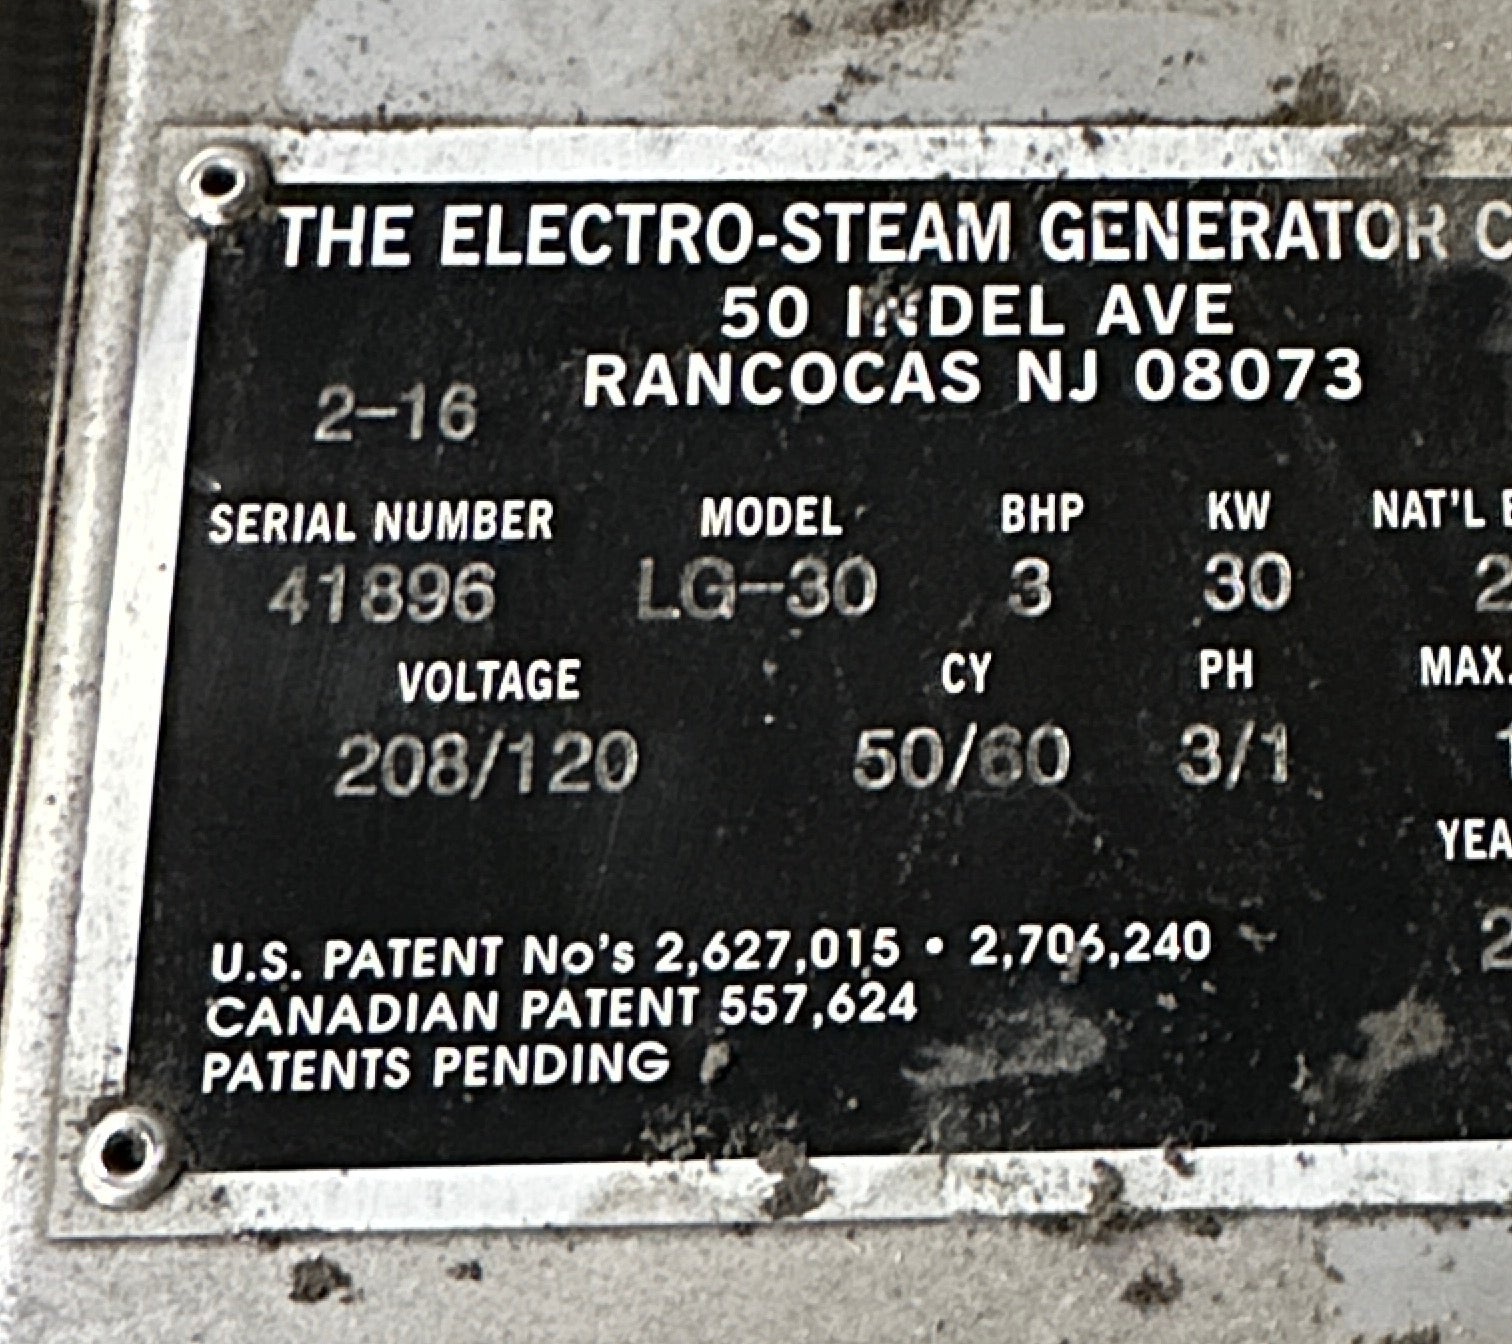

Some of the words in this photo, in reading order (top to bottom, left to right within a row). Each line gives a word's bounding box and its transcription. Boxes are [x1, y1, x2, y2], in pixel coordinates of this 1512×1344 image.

[276, 204, 412, 268] THE
[441, 201, 1013, 266] ELECTRO-STEAM
[1041, 201, 1445, 263] GENERATOR
[721, 285, 807, 338] 50
[1096, 283, 1234, 336] AVE
[583, 352, 980, 408] RANCOCAS
[1017, 350, 1100, 402] NJ
[1135, 348, 1363, 402] 08073
[314, 382, 479, 442] 2-16
[208, 502, 356, 542] SERIAL
[373, 500, 554, 541] NUMBER
[701, 496, 843, 536] MODEL
[1001, 494, 1084, 532] BHP
[1208, 491, 1271, 530] KW
[1373, 488, 1485, 529] NAT'L
[268, 561, 497, 625] 41896
[638, 556, 878, 621] LG-30
[1007, 558, 1052, 616] 3
[1203, 553, 1293, 613] 30
[398, 659, 580, 702] VOLTAGE
[941, 653, 992, 694] CY
[1200, 649, 1253, 689] PH
[334, 729, 639, 800] 208/120
[852, 721, 1072, 793] 50/60
[1177, 721, 1289, 791] 3/1
[211, 941, 301, 982] U.S.
[323, 935, 502, 979] PATENT
[524, 933, 634, 975] No's
[655, 929, 899, 979] 2,627,015
[970, 920, 1211, 968] 2,706,240
[207, 991, 498, 1038] CANADIAN
[522, 987, 699, 1030] PATENT
[718, 983, 917, 1028] 557,624
[201, 1048, 410, 1094] PATENTS
[433, 1041, 670, 1088] PENDING
